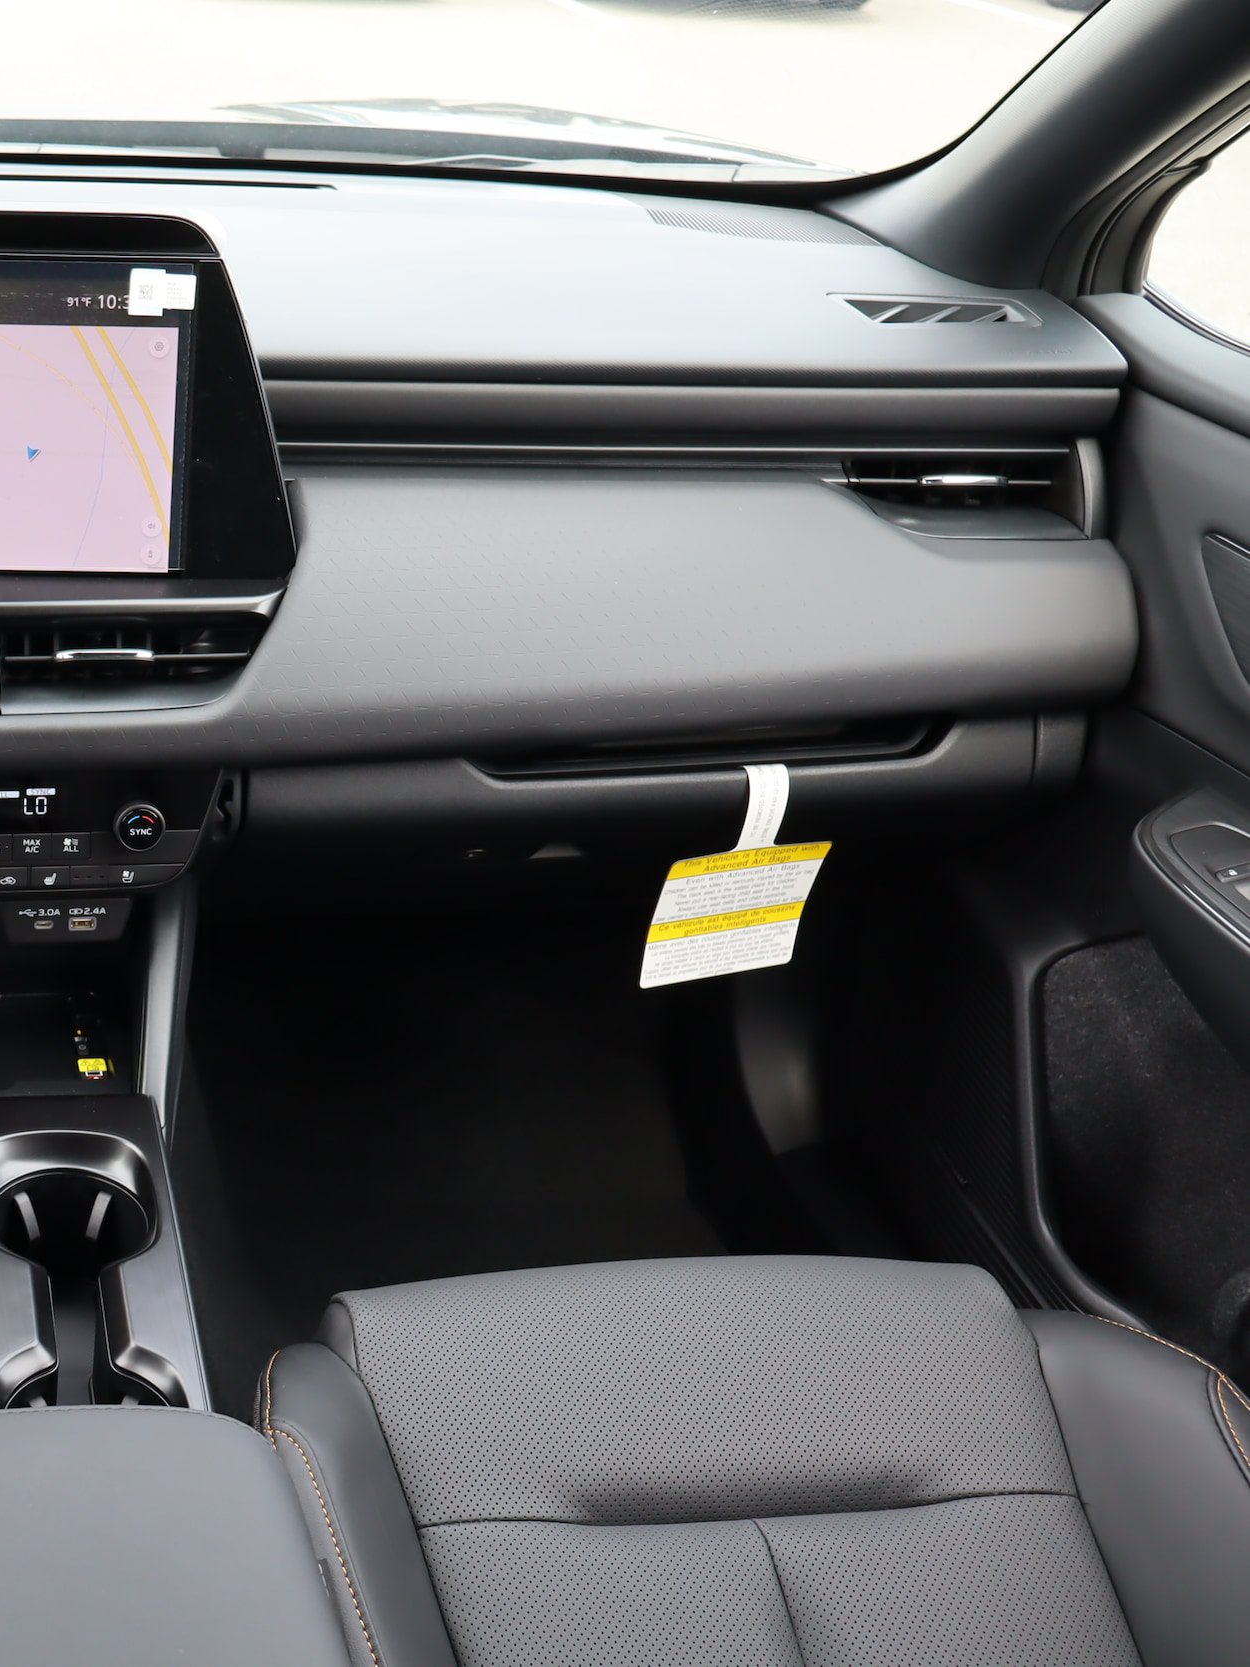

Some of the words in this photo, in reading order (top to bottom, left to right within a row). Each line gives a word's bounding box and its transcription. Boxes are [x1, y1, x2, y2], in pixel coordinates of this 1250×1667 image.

[98, 294, 129, 309] 10:3
[24, 796, 48, 815] LO
[130, 828, 153, 836] SYNC
[684, 860, 702, 868] This
[706, 853, 739, 864] Vehicle
[754, 846, 798, 859] Equipped
[703, 860, 748, 873] Advanced
[768, 854, 792, 864] Bags
[727, 868, 765, 878] Advanced
[38, 908, 61, 916] 3.0A
[84, 907, 107, 915] 2.4A
[673, 918, 705, 929] véhicule
[762, 905, 797, 915] coussins
[684, 924, 723, 937] gonflables
[726, 917, 767, 928] intelligents
